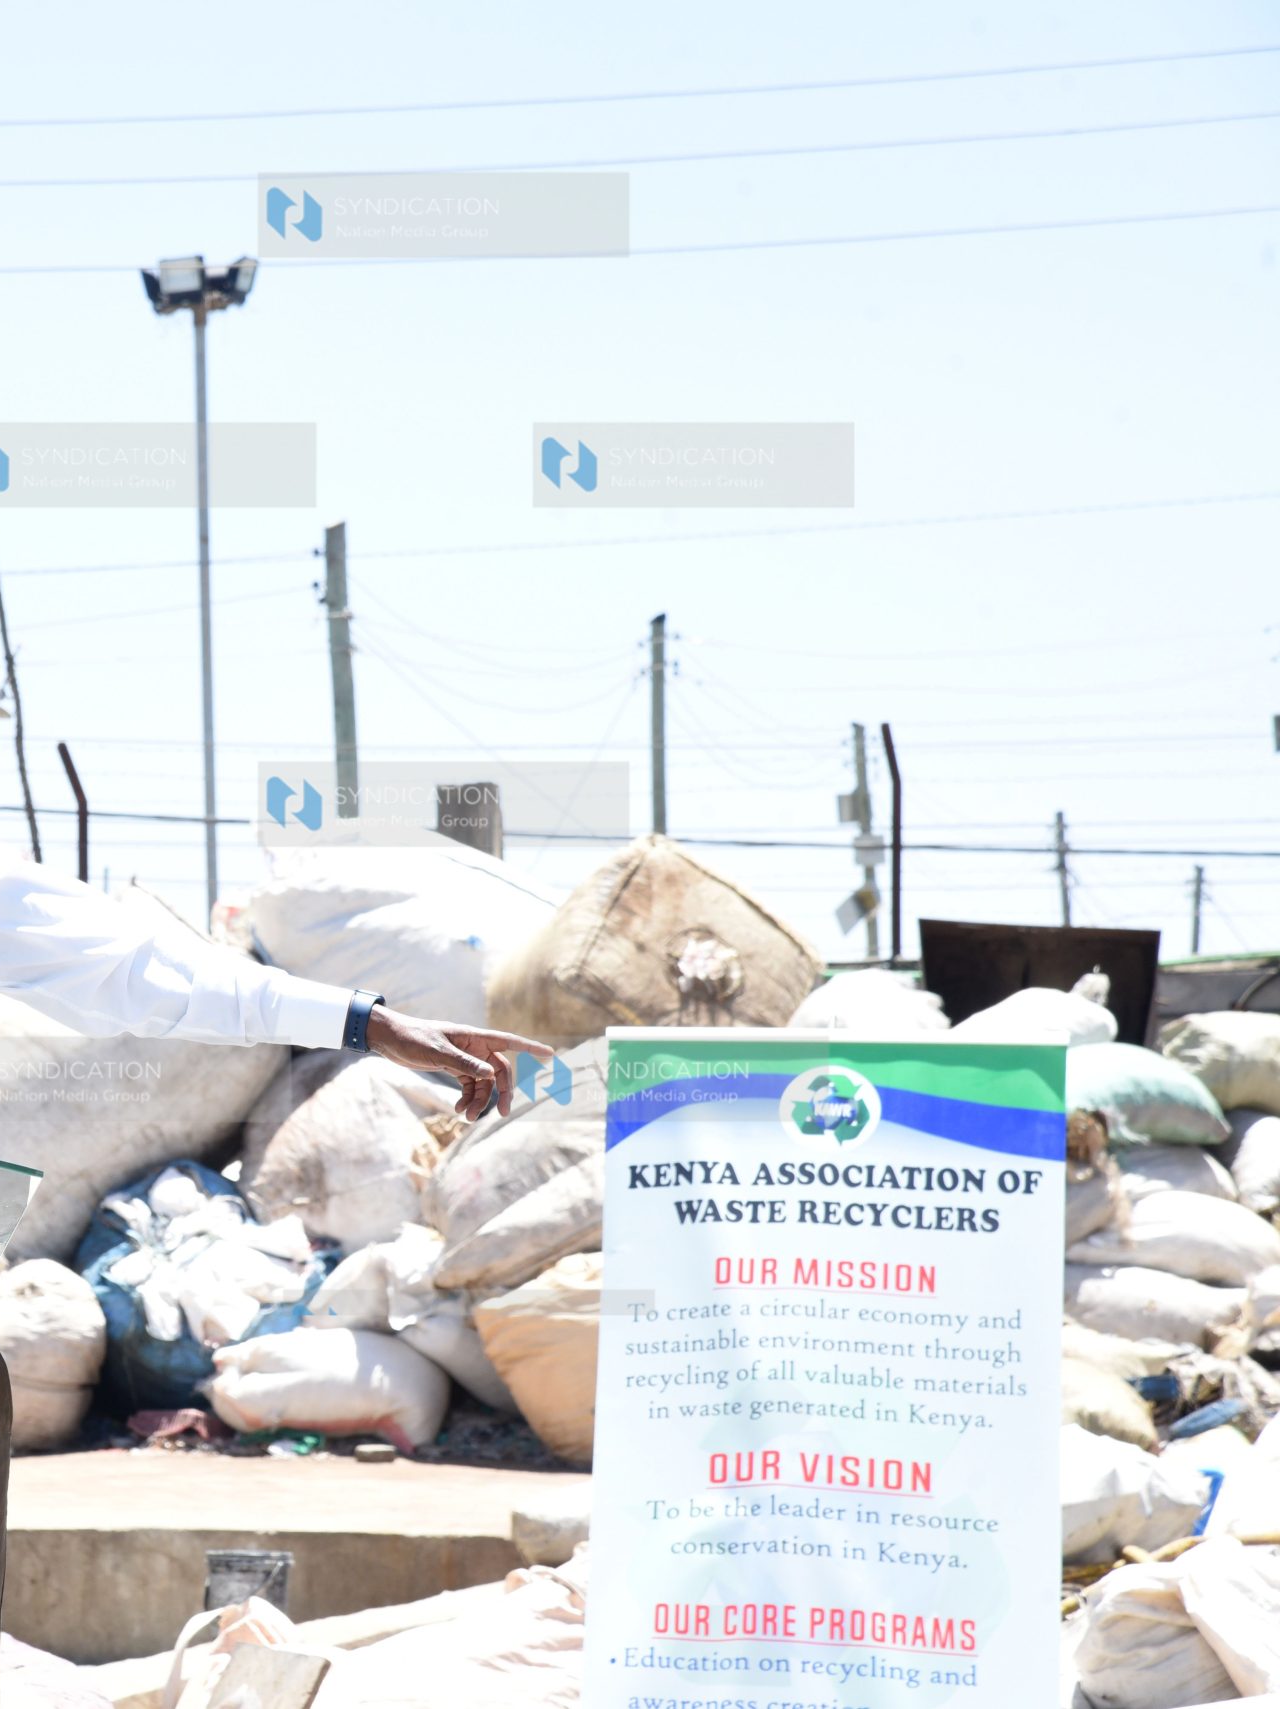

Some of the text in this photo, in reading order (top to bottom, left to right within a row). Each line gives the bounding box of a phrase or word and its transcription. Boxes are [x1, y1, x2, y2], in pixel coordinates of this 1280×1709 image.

[628, 1161, 1043, 1194] KENYA ASSOCIATION OF
[674, 1199, 1000, 1232] WASTE RECYCLERS
[715, 1257, 936, 1293] OUR MISSION
[628, 1298, 1022, 1334] To create a circular economy and
[625, 1328, 1022, 1368] sustainable environment through
[626, 1360, 1027, 1396] recycling of all valuable materials
[648, 1399, 993, 1434] in waste generated in Kenya.
[709, 1450, 931, 1492] OUR VISION
[646, 1495, 999, 1532] To be the leader in resource
[670, 1536, 968, 1574] conservation in Kenya.
[654, 1603, 976, 1651] OUR CORE PROGRAMS
[624, 1646, 977, 1689] Education on recycling and
